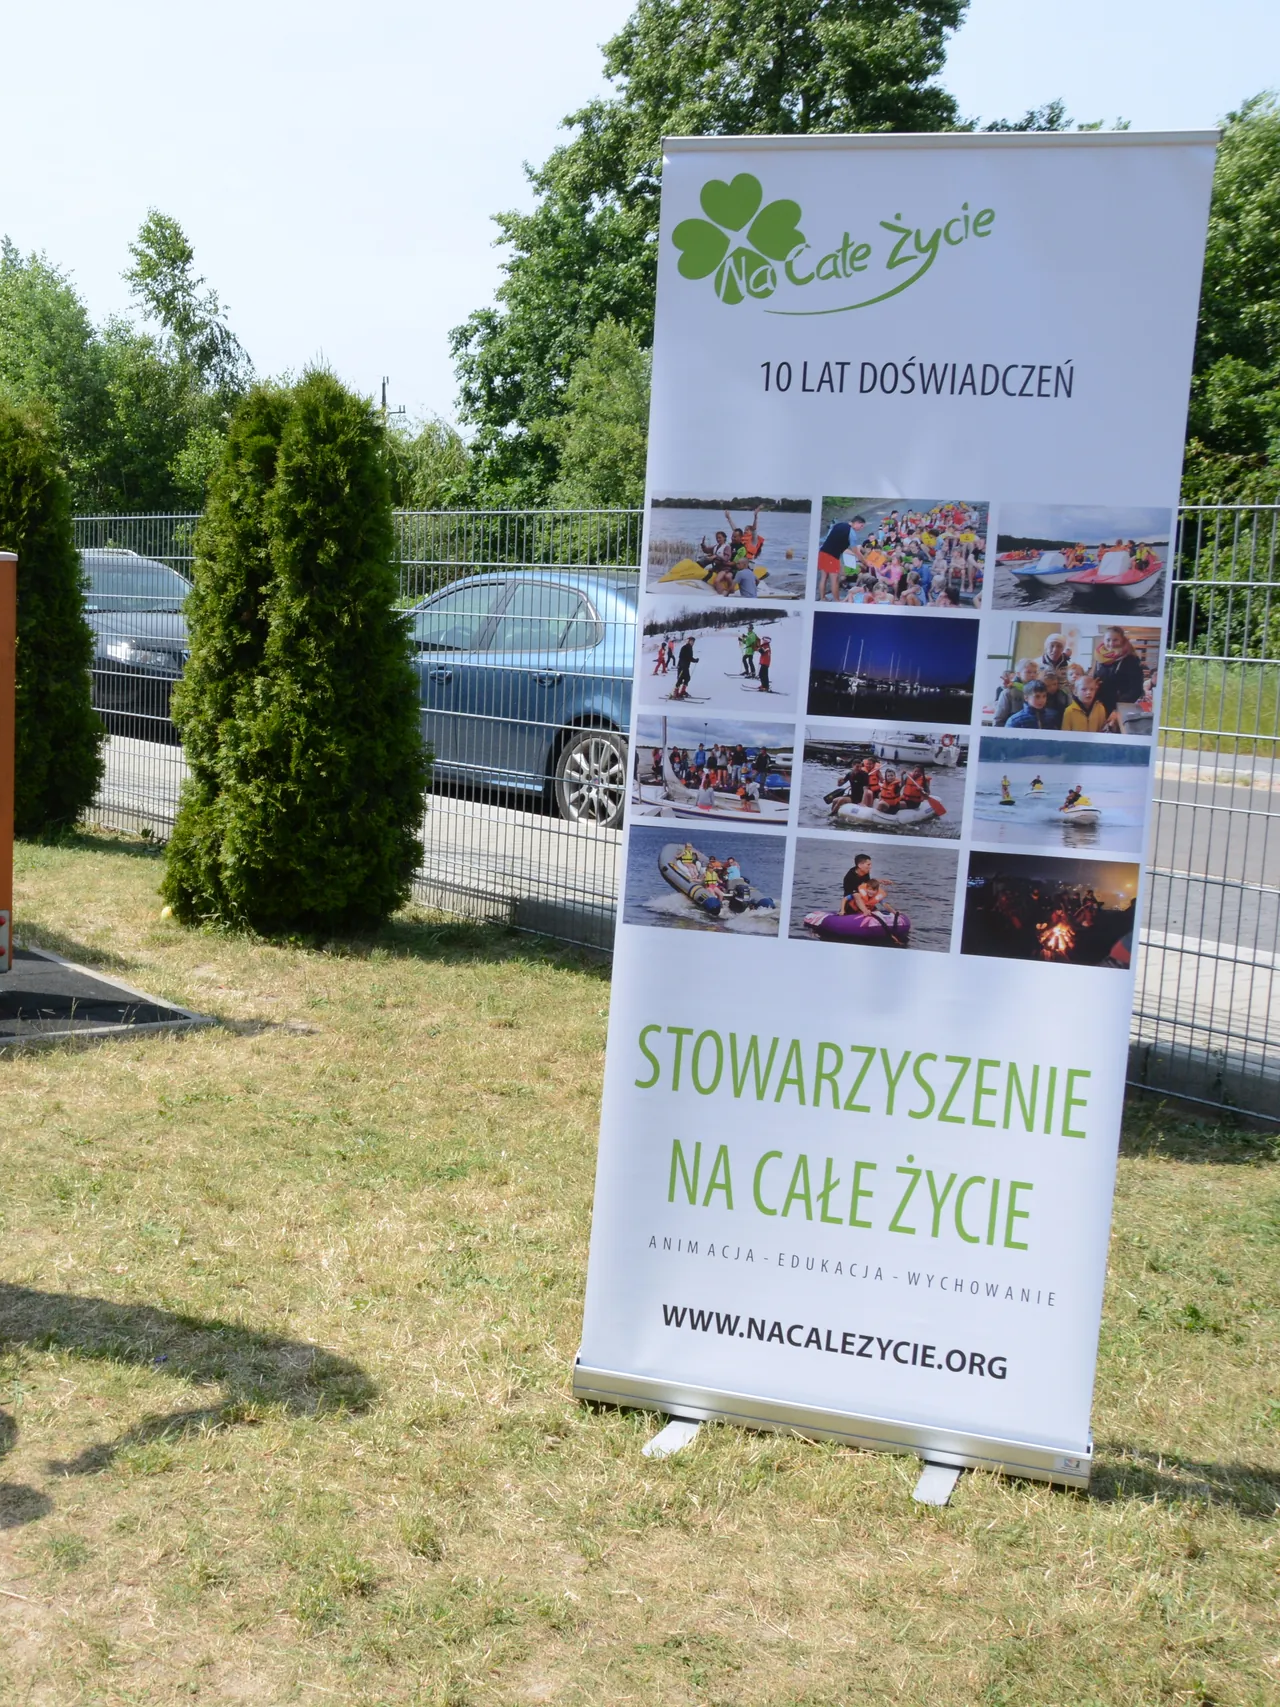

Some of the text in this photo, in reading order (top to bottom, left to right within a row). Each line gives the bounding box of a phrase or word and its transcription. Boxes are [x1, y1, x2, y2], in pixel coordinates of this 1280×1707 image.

[719, 255, 776, 299] Na
[878, 201, 996, 272] Życie
[760, 355, 1075, 399] 10 LAT DOŚWIADCZEŃ
[633, 1023, 1092, 1140] STOWARZYSZENIE
[667, 1138, 1035, 1252] NA CAŁE ŻYCIE
[648, 1234, 755, 1263] ANIMACJA
[777, 1252, 883, 1281] EDUKACJA
[907, 1271, 1057, 1308] WYCHOWANIE
[661, 1303, 1008, 1381] WWW.NACALEZYCIE.ORG
